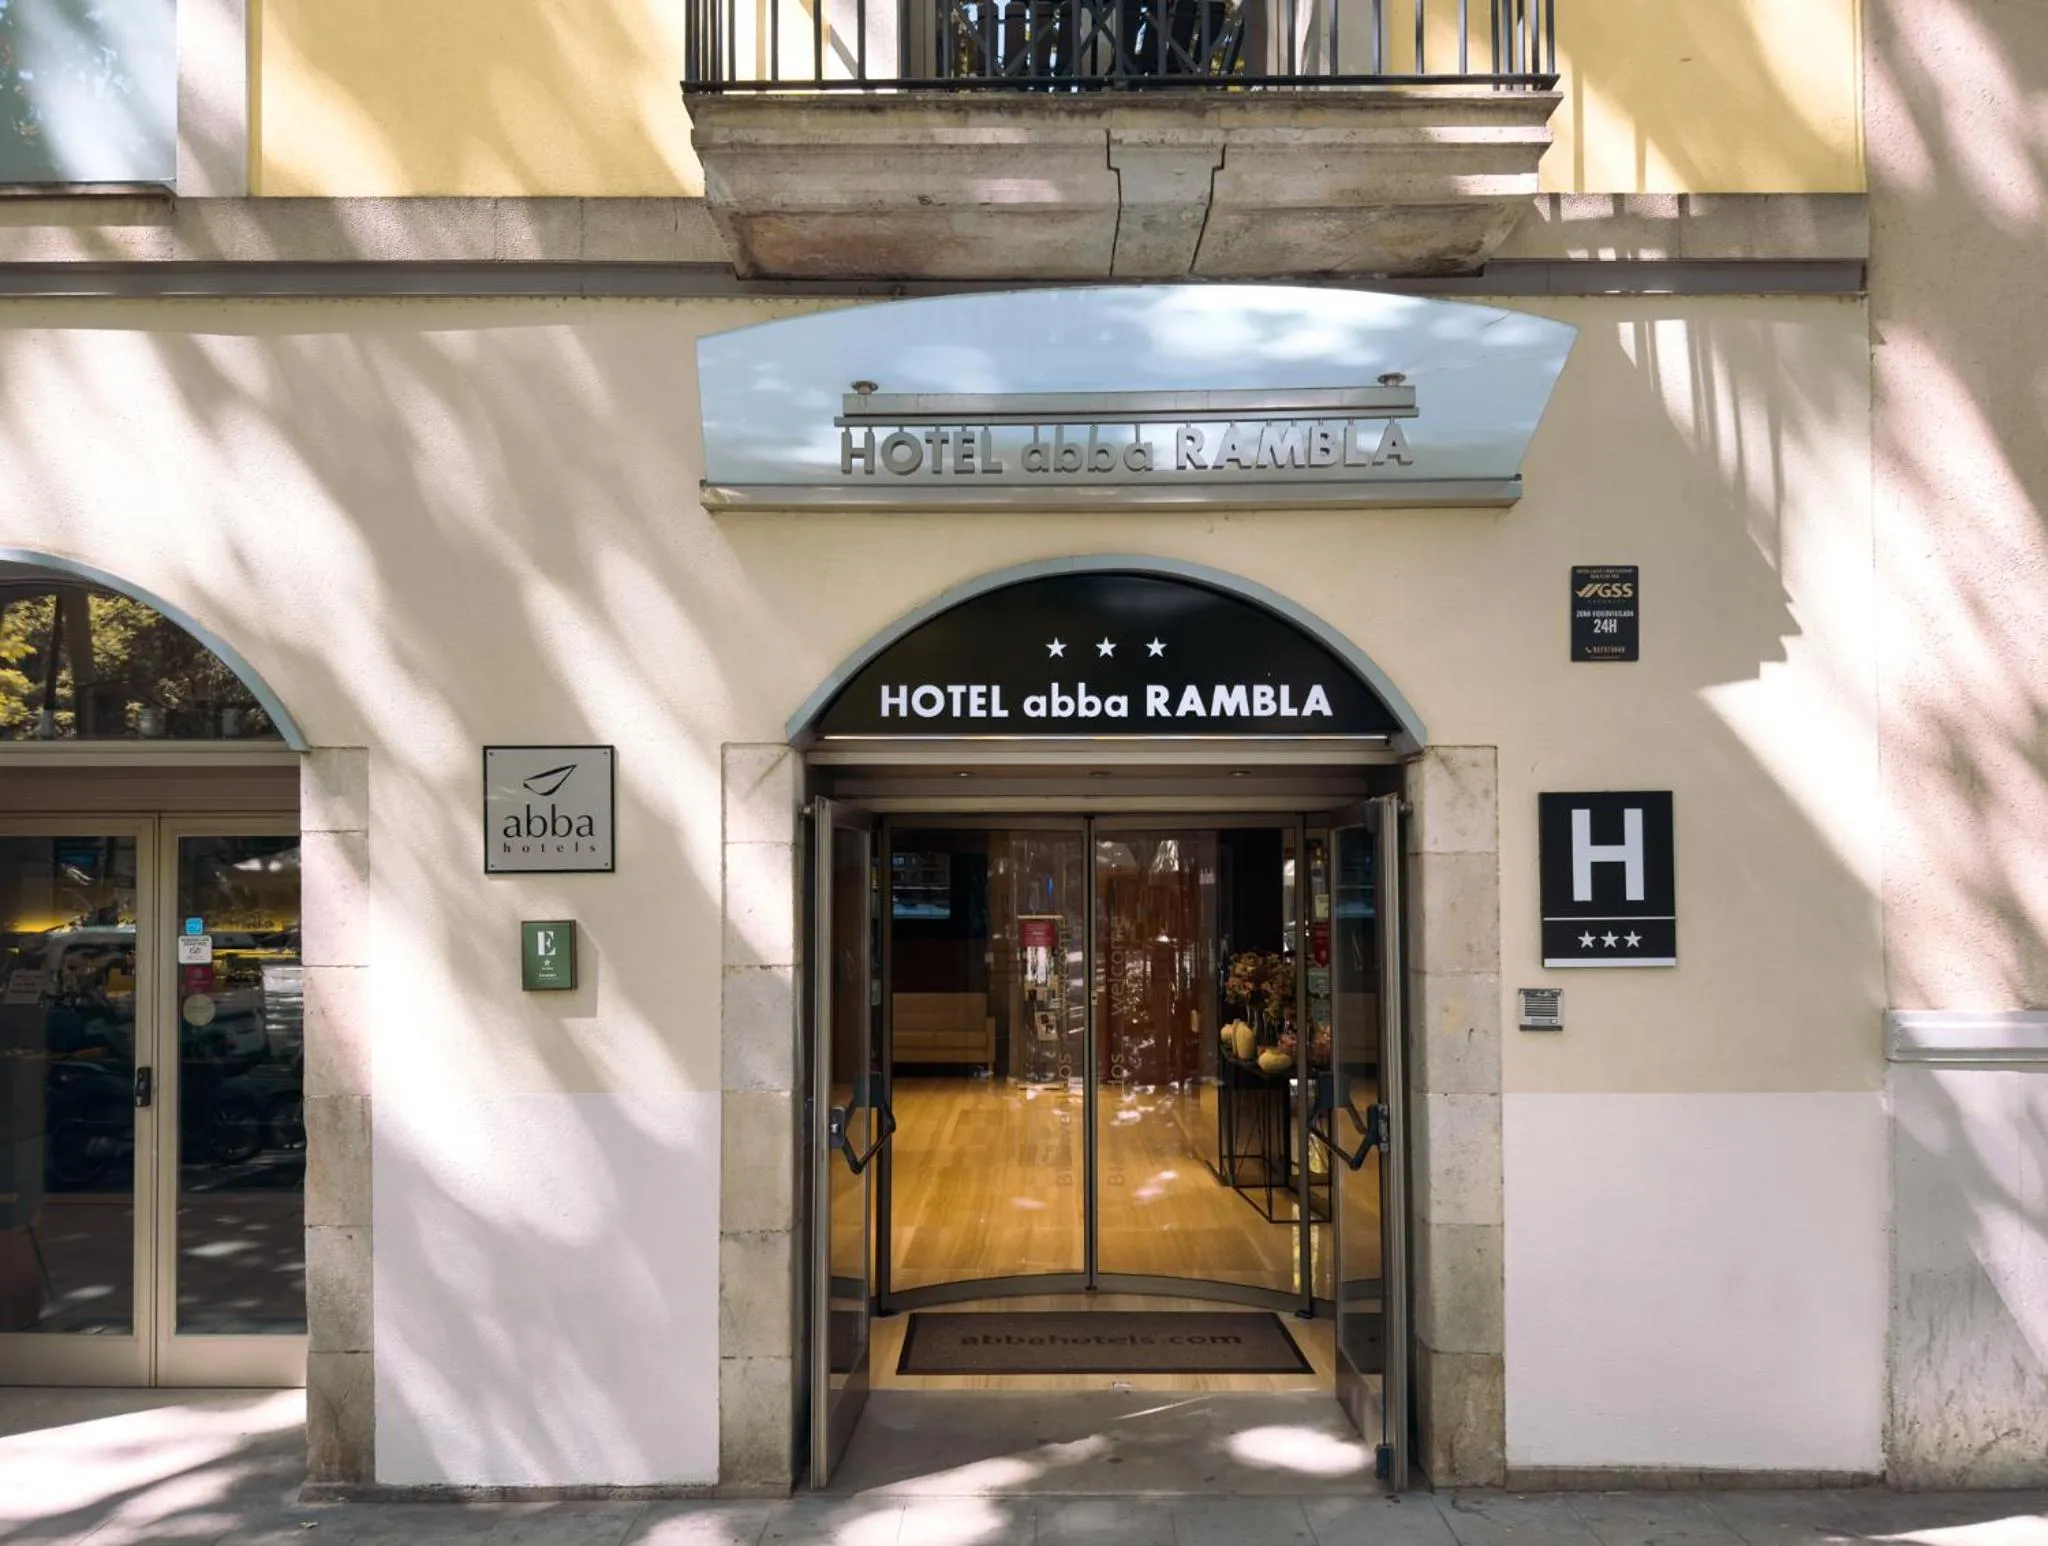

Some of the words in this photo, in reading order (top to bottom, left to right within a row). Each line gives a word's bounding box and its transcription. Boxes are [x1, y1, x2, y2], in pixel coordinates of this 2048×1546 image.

[840, 429, 1003, 475] HOTEL
[1021, 428, 1153, 473] abba
[1176, 425, 1414, 471] RAMBLA
[1597, 583, 1633, 598] GSS
[1593, 619, 1617, 633] 24H
[881, 684, 1009, 718] HOTEL
[1023, 682, 1129, 718] abba
[1146, 684, 1333, 717] RAMBLA
[503, 804, 595, 838] abba
[503, 842, 597, 853] hotels
[1572, 808, 1645, 901] H
